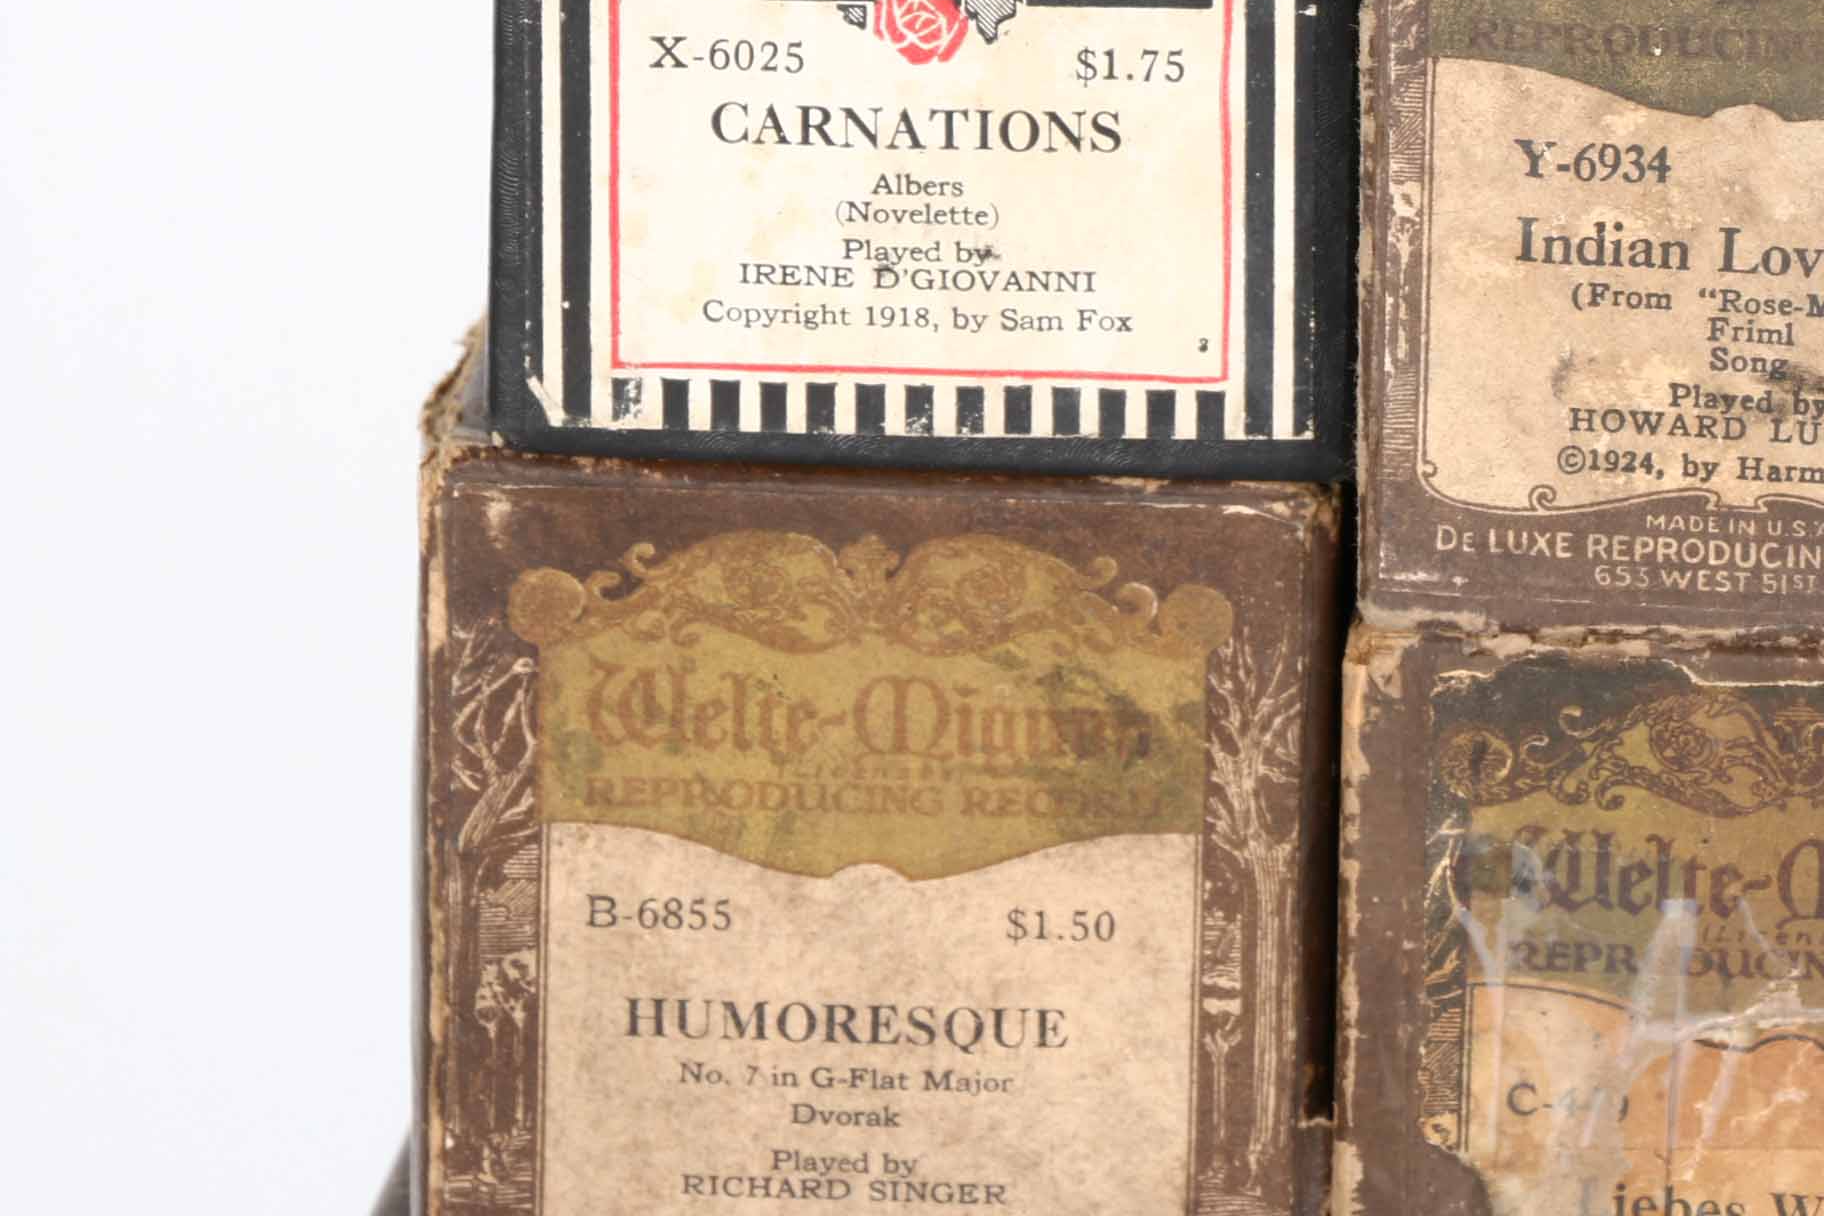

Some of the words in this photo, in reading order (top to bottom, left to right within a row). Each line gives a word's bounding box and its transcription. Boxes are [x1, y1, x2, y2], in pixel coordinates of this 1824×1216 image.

[649, 36, 804, 73] X-6025
[1076, 47, 1184, 87] $1.75
[711, 103, 1121, 152] CARNATIONS
[1514, 139, 1672, 184] Y-6934
[871, 173, 963, 197] Albers
[836, 201, 999, 229] (Novelette)
[843, 238, 941, 266] Played
[955, 241, 1001, 267] by
[1515, 217, 1690, 270] Indian
[740, 263, 854, 288] IRENE
[873, 263, 1095, 292] D'GIOVANNI
[1571, 282, 1672, 311] (From
[702, 299, 851, 330] Copyright
[866, 306, 938, 332] 1918,
[952, 306, 988, 333] by
[1000, 304, 1064, 332] Sam
[1077, 309, 1133, 332] Fox
[1706, 317, 1795, 347] Friml
[1709, 346, 1789, 379] Song
[1669, 383, 1774, 417] Played
[1569, 409, 1745, 441] HOWARD
[1682, 453, 1723, 484] by
[1646, 515, 1722, 533] MADE
[1729, 519, 1756, 536] IN
[1489, 528, 1572, 558] LUXE
[1661, 570, 1751, 592] WEST
[585, 894, 732, 931] B-6855
[1006, 907, 1116, 945] $1.50
[624, 997, 1067, 1054] HUMORESQUE
[678, 1063, 731, 1086] No.
[771, 1065, 800, 1088] in
[810, 1066, 908, 1091] G-Flat
[921, 1066, 1014, 1096] Major
[791, 1102, 901, 1128] Dvorak
[770, 1149, 869, 1178] Played
[882, 1152, 918, 1178] by
[682, 1173, 852, 1201] RICHARD
[869, 1178, 1006, 1205] SINGER
